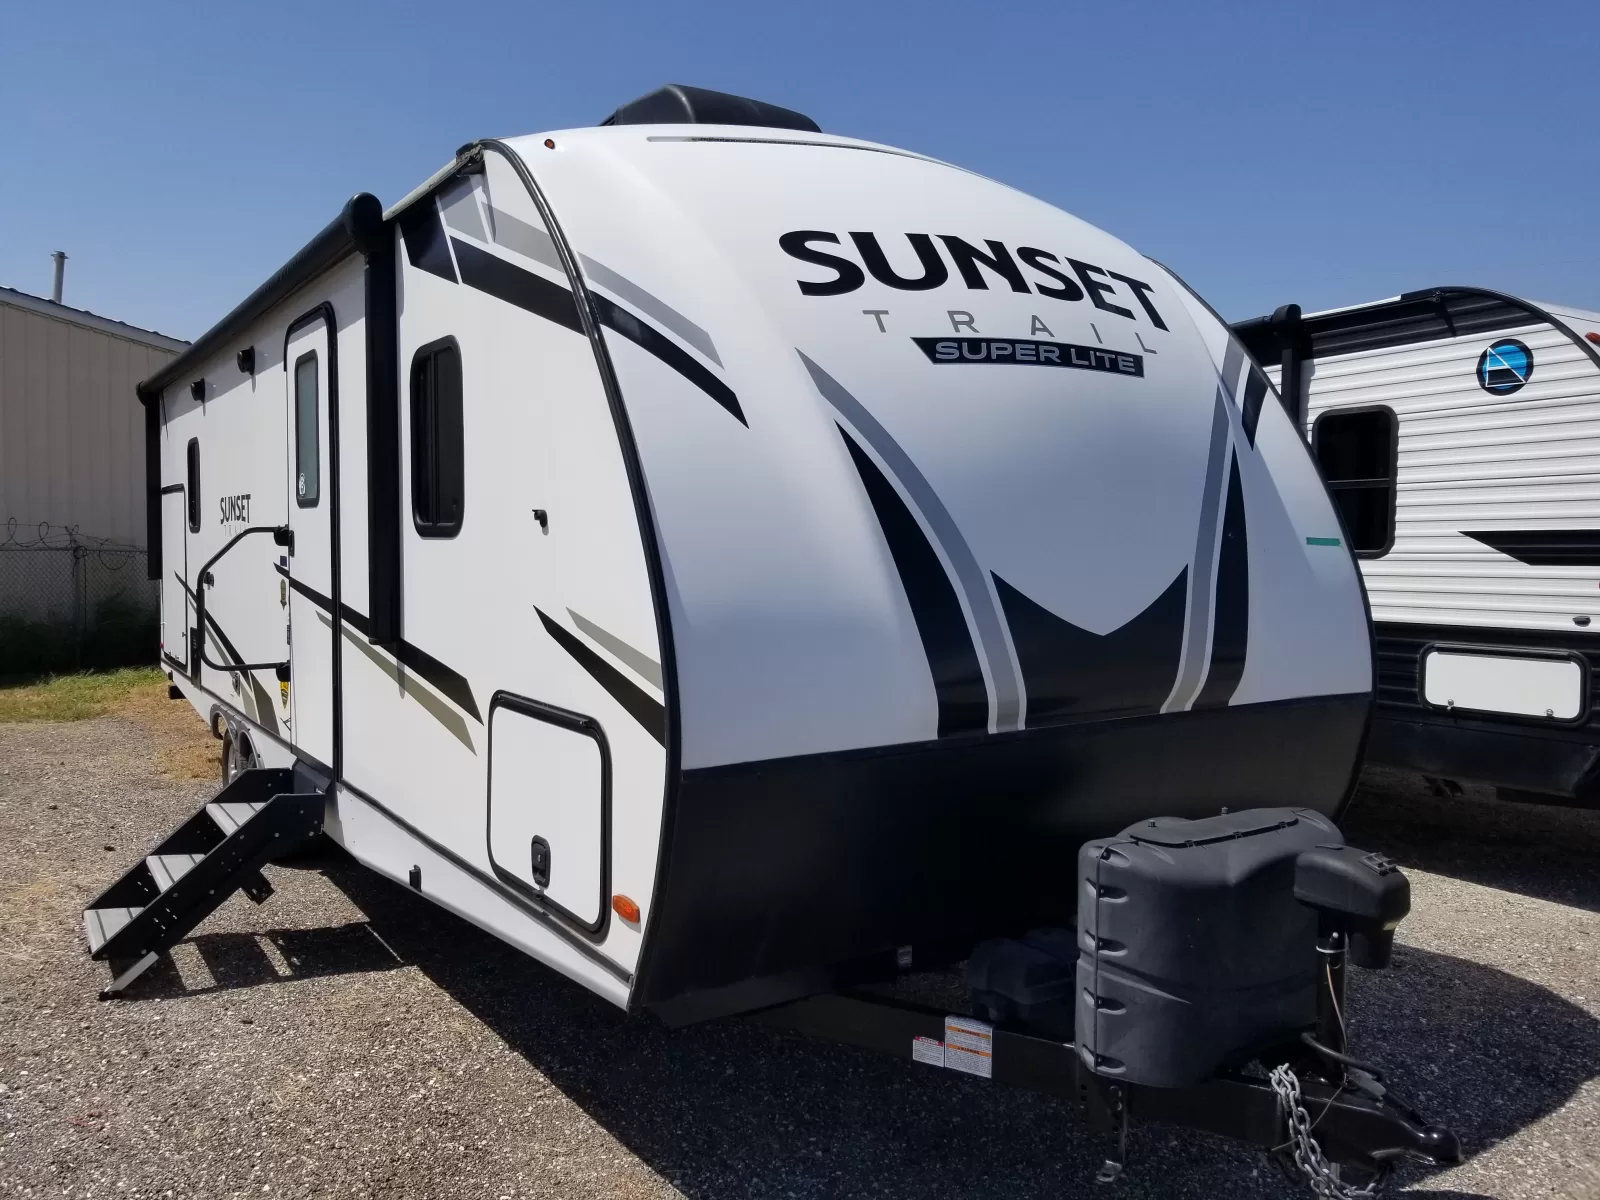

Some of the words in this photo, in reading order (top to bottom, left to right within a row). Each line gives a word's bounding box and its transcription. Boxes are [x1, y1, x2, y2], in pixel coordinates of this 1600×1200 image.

[778, 230, 1170, 332] SUNSET
[862, 310, 1157, 355] TRAIL
[935, 342, 1062, 363] SUPER
[1070, 348, 1136, 373] LITE
[220, 494, 251, 525] SUNSET
